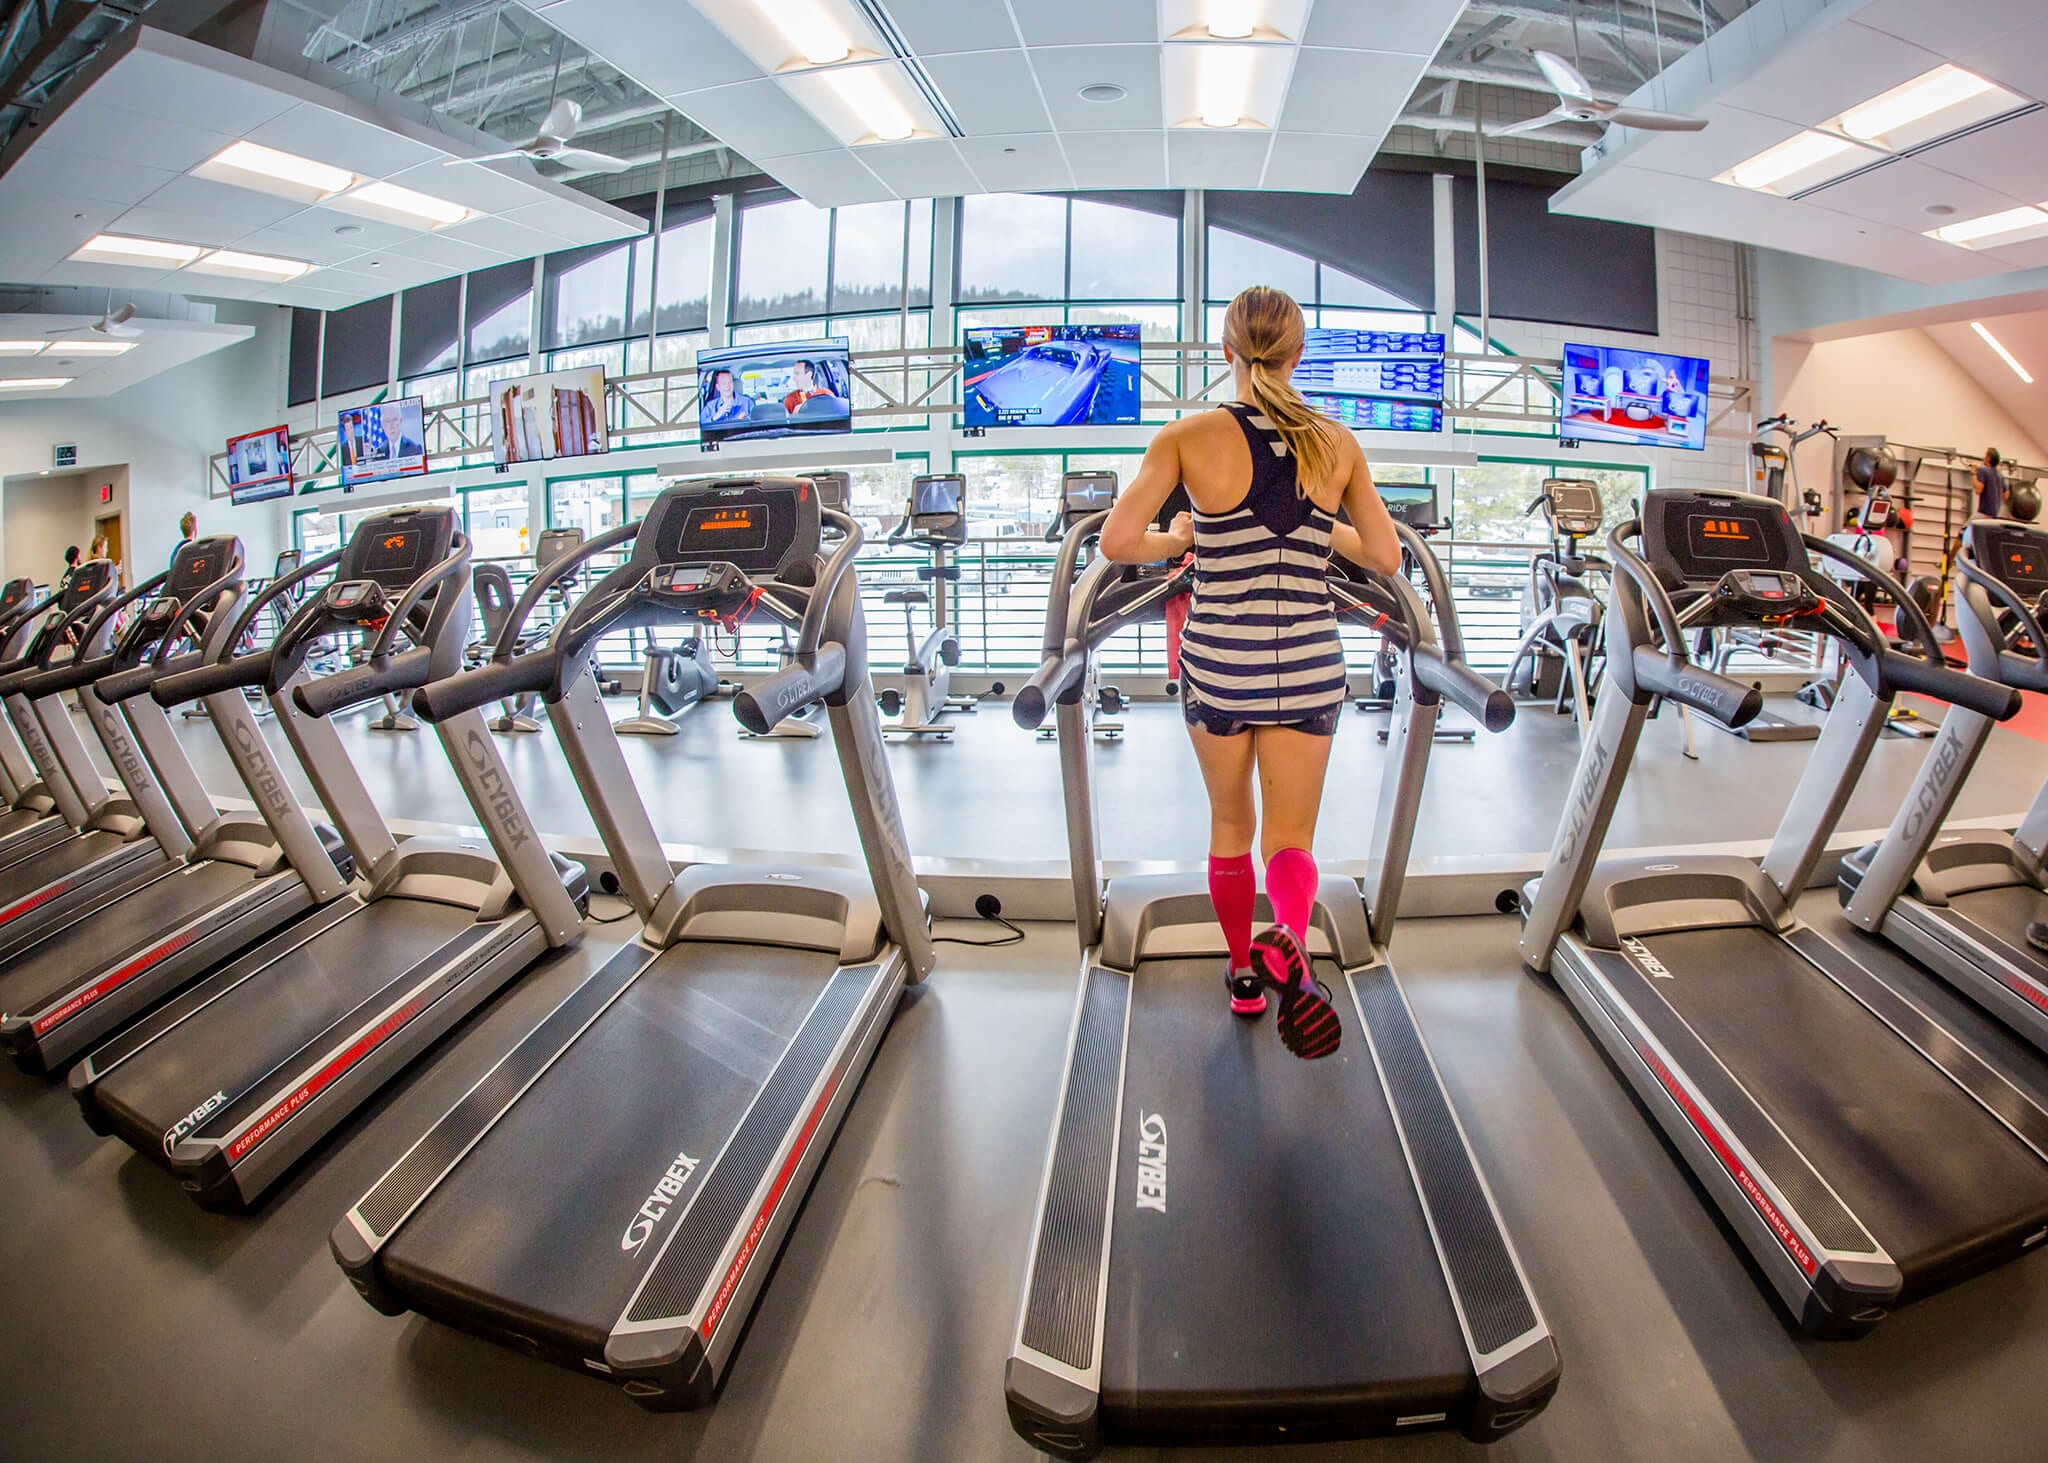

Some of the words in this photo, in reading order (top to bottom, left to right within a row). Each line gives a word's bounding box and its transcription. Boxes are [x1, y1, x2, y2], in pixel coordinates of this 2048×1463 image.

[1387, 503, 1408, 512] RIDE
[1690, 677, 1724, 707] CYBEX
[112, 735, 151, 794] CYBEX
[245, 749, 294, 820] CYBEX
[1572, 738, 1608, 840] CYBEX
[1918, 728, 1965, 814] CYBEX
[479, 766, 531, 851] CYBEX
[1633, 943, 1675, 980] CYBEX
[40, 999, 81, 1030] PERFORMANCE
[82, 989, 99, 1004] PLUS
[175, 1090, 228, 1138] CYBEX
[235, 1103, 290, 1154] PERFORMANCE
[289, 1088, 310, 1109] PLUS
[639, 1152, 701, 1223] CYBEX
[1136, 1141, 1168, 1213] CYBEX
[1737, 1169, 1791, 1242] PERFORMANCE
[1789, 1236, 1811, 1266] PLUS
[707, 1243, 751, 1329] PERFORMANCE
[749, 1214, 765, 1246] PLUS
